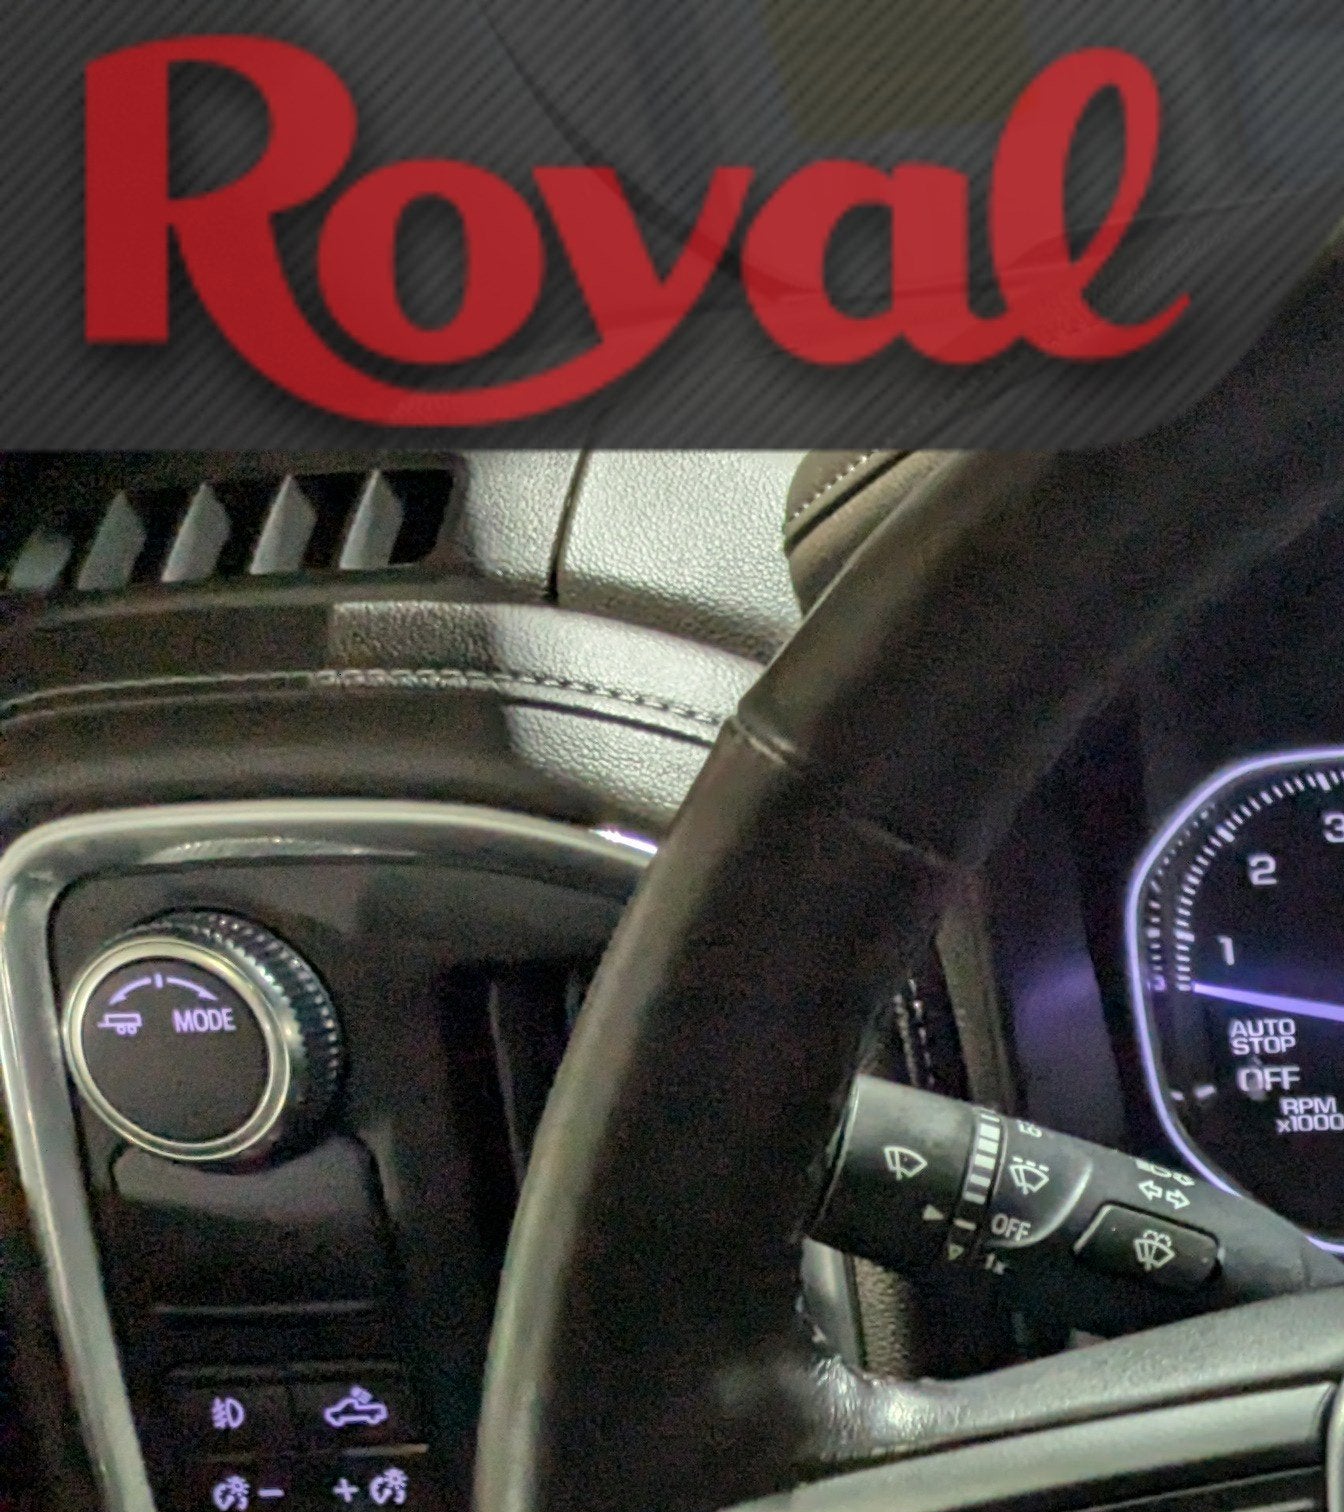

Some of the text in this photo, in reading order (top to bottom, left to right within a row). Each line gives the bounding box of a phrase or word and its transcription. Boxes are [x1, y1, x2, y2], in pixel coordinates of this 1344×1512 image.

[1248, 855, 1278, 886] 2
[1217, 936, 1236, 967] 1
[172, 1007, 238, 1034] MODE
[1229, 1017, 1297, 1038] AUTO
[1231, 1036, 1297, 1056] STOP
[1237, 1066, 1301, 1092] OFF
[1278, 1096, 1338, 1115] RPM
[990, 1212, 1032, 1241] OFF
